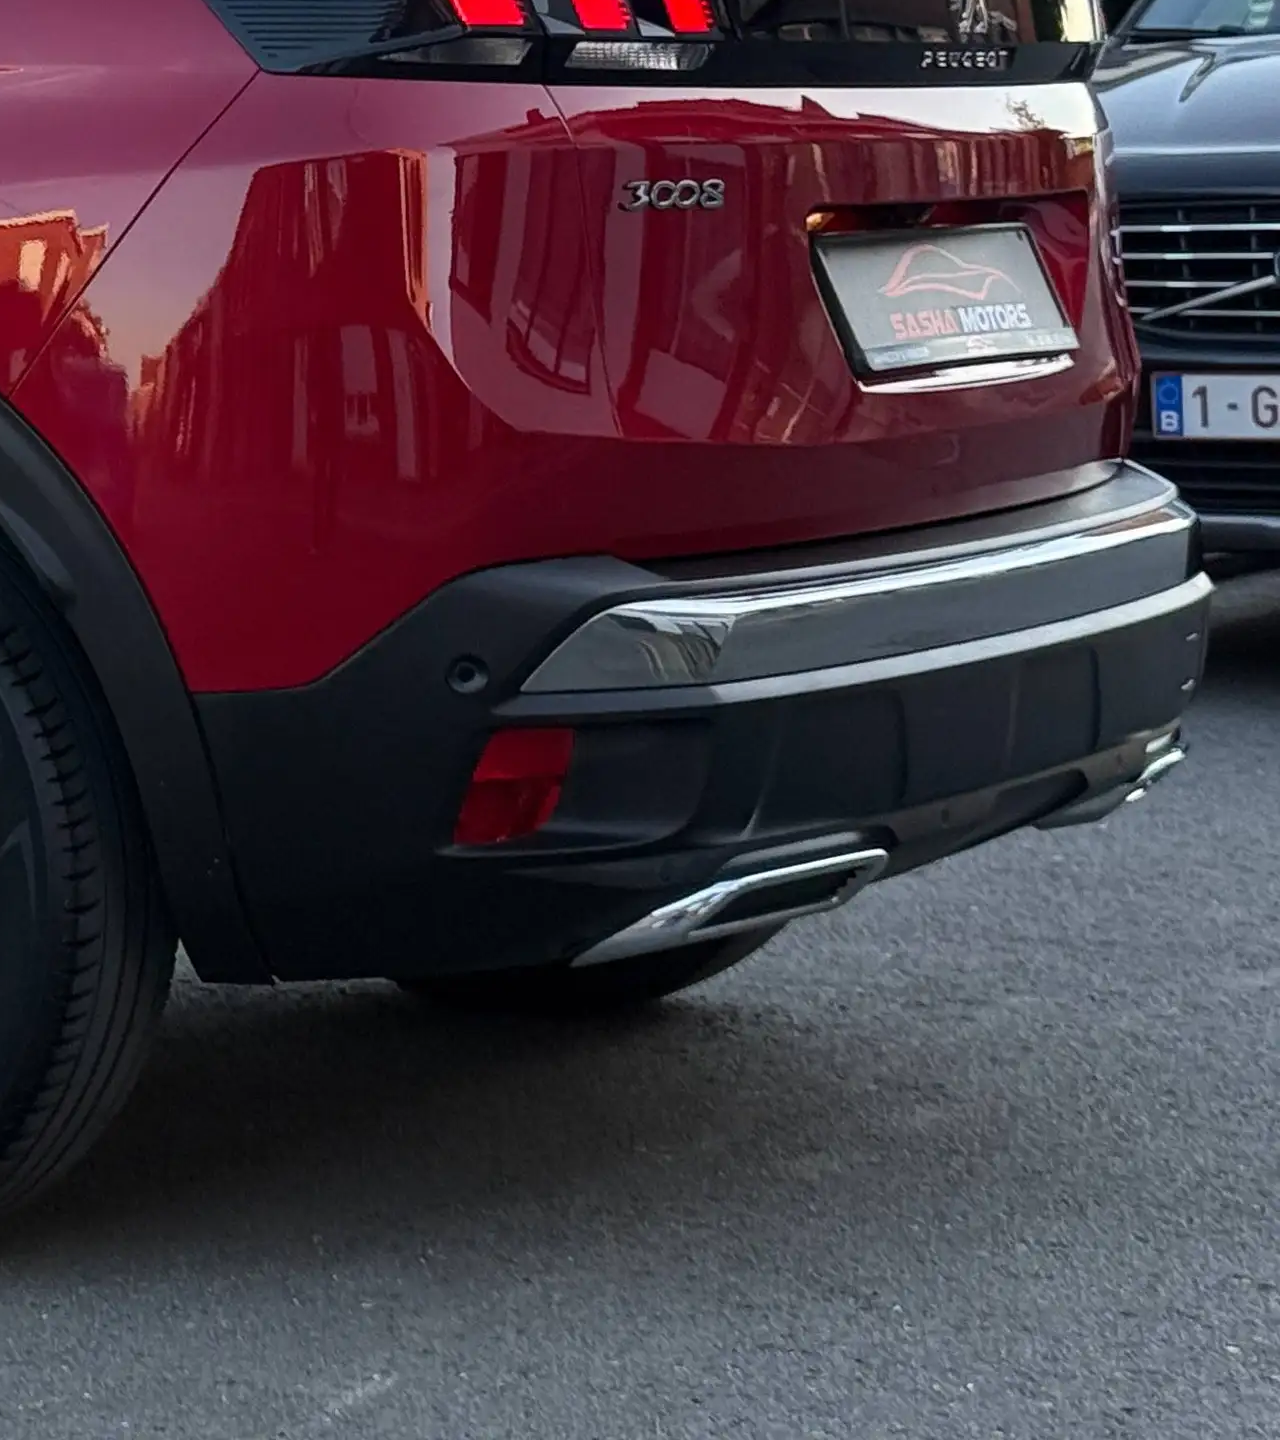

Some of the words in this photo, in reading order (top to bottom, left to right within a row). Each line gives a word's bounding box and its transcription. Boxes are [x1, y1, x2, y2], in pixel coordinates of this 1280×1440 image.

[920, 49, 1009, 69] PEUGEOT
[617, 178, 726, 212] 3008
[890, 308, 961, 340] SASHA
[958, 303, 1033, 334] MOTORS
[1160, 410, 1180, 432] B
